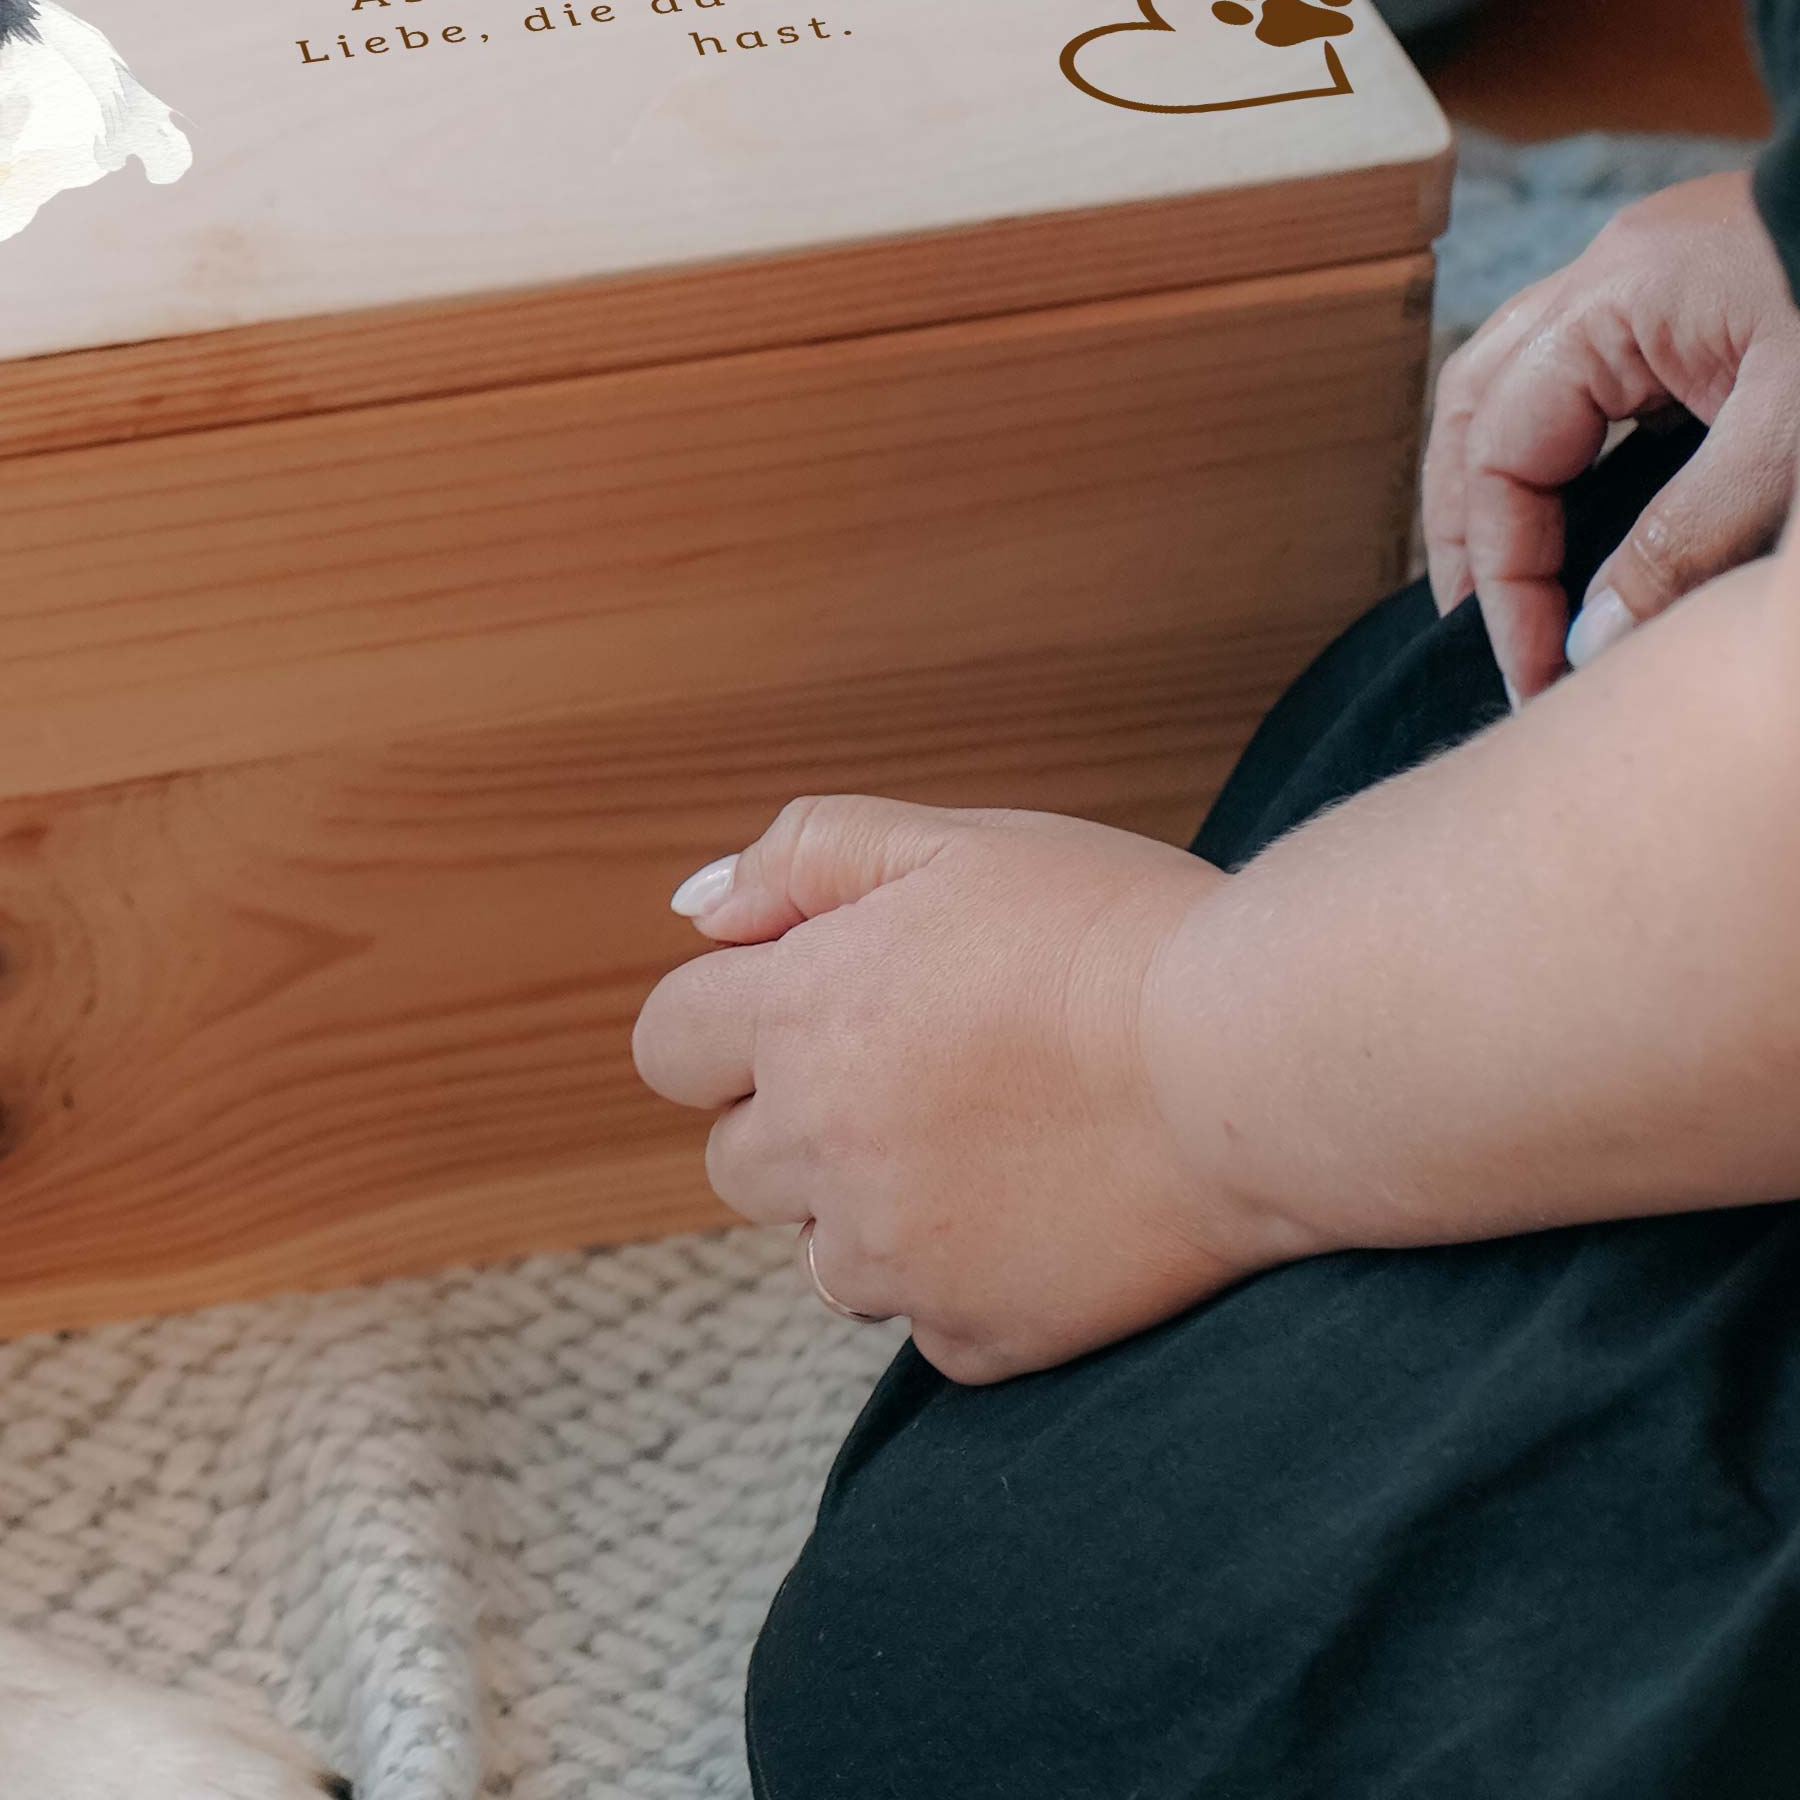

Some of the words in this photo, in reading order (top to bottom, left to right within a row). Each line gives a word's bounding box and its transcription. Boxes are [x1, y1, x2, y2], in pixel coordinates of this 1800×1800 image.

[296, 26, 488, 64] Liebe,
[524, 3, 615, 32] die
[688, 18, 852, 55] hast.
